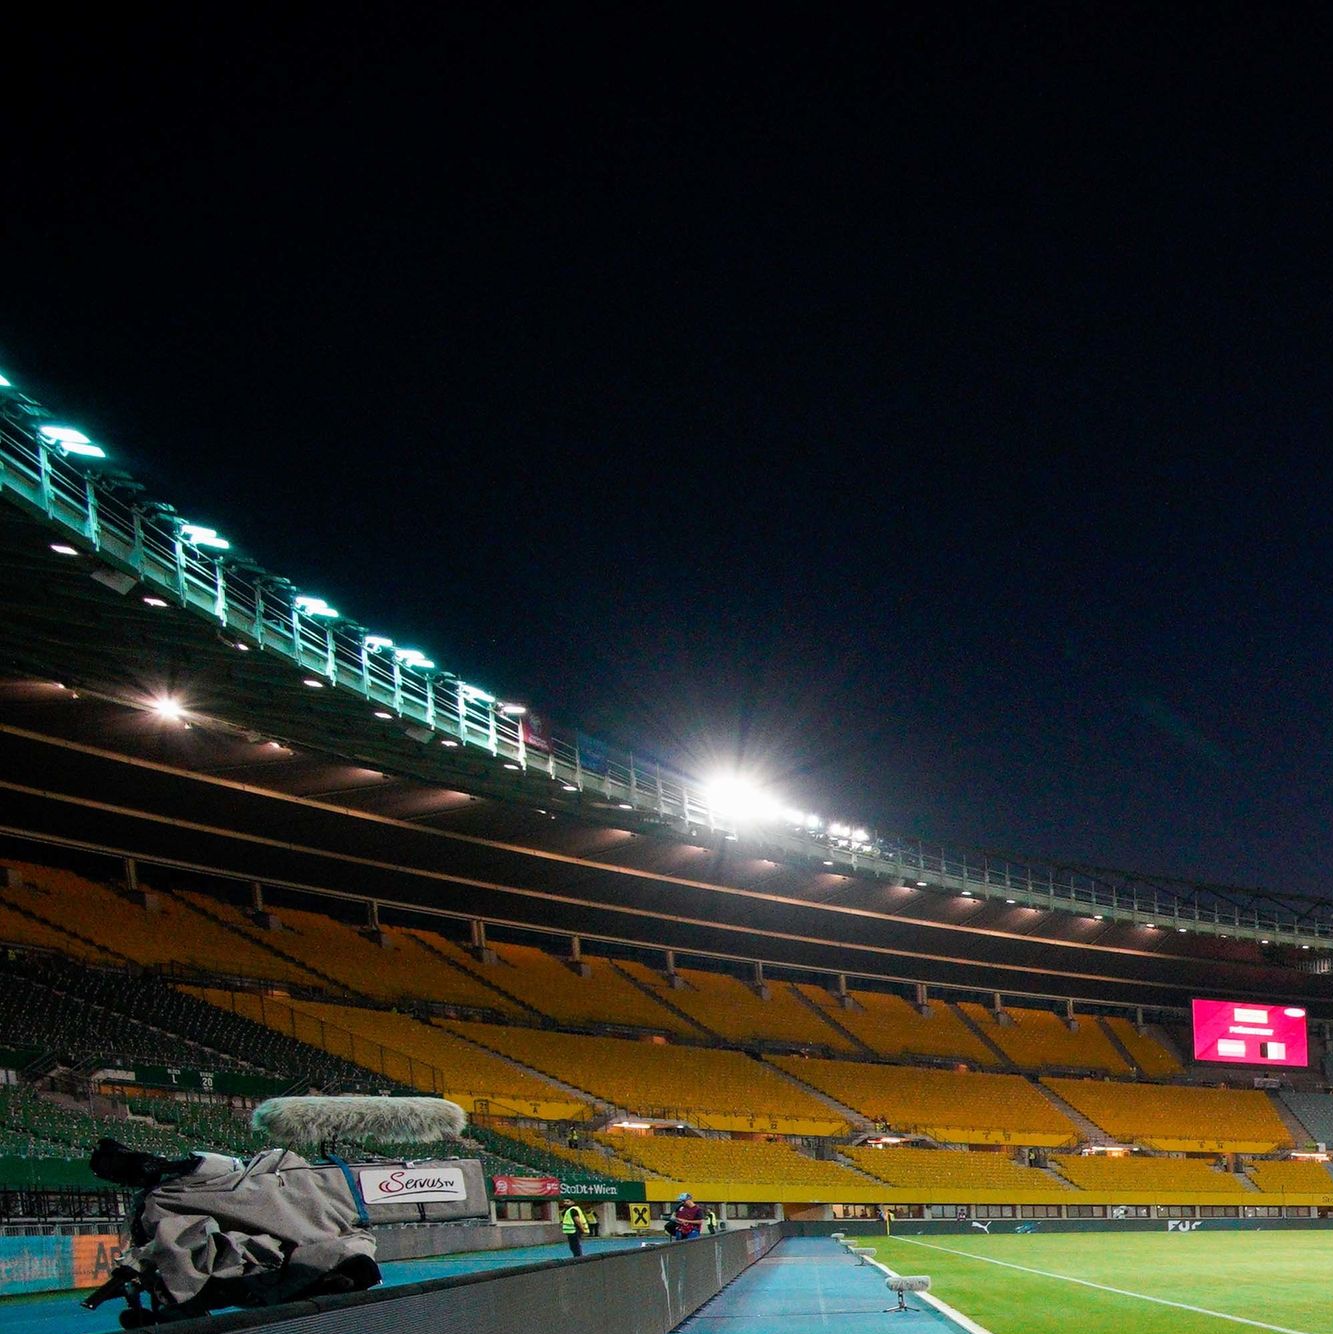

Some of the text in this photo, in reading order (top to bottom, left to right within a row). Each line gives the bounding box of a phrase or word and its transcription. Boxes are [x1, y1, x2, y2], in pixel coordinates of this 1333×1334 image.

[172, 1075, 178, 1084] L
[202, 1077, 213, 1087] 20
[593, 1184, 618, 1195] Wien
